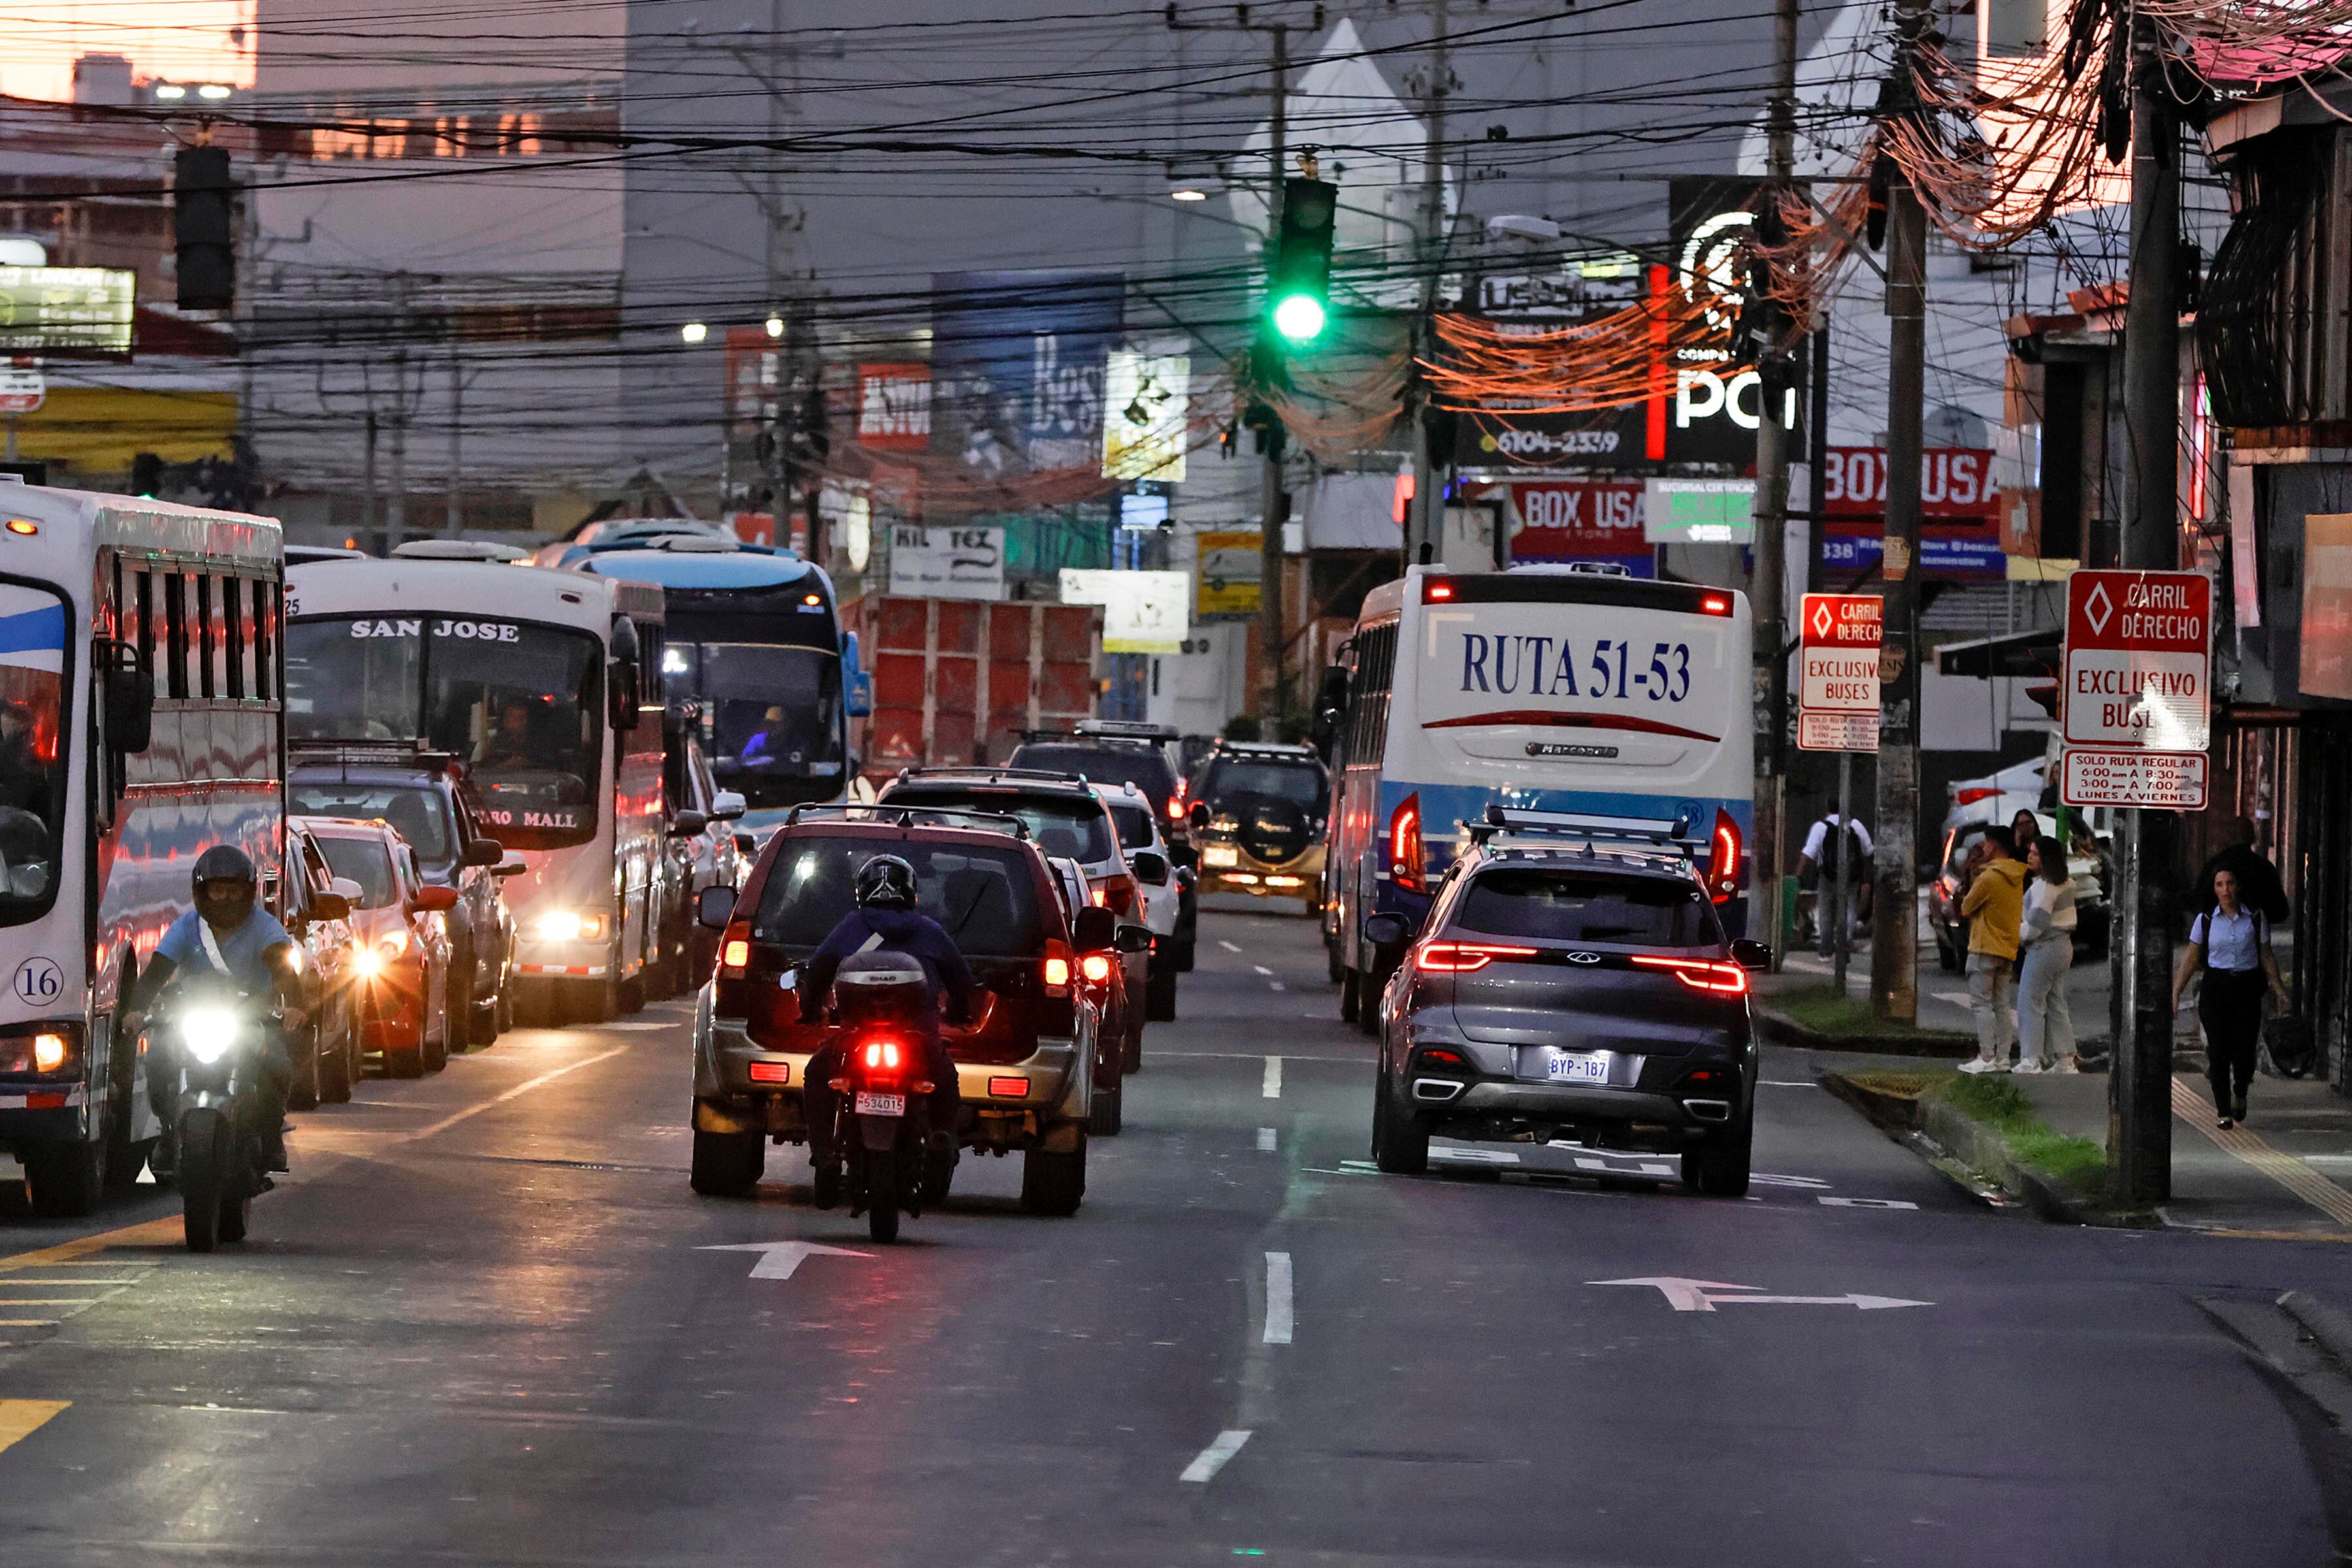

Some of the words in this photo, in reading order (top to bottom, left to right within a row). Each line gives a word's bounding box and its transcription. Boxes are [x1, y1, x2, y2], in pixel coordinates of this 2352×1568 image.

[1705, 482, 1757, 493] CERTIFICAD
[1525, 490, 1582, 528] BOX
[2127, 583, 2190, 610] CARRIL
[1840, 603, 1882, 621] CARRIL
[351, 621, 422, 638] SAN
[434, 621, 520, 643] JOSE
[2122, 614, 2200, 640] DERECHO
[1461, 633, 1579, 696] RUTA
[1590, 640, 1690, 702] 51-53
[1825, 683, 1870, 700] BUSES
[2078, 670, 2196, 696] EXCLUSIVO
[2076, 755, 2106, 765] SOLO
[2110, 757, 2138, 766] RUTA
[2142, 758, 2197, 768] REGULAR
[2082, 768, 2110, 777] 6:00
[2130, 769, 2139, 778] A
[2146, 770, 2174, 779] 8:30
[2081, 779, 2109, 788] 3:00
[2130, 781, 2139, 790] A
[2146, 781, 2173, 790] 7:00
[2138, 792, 2196, 802] VIERNES
[523, 812, 577, 828] MALL
[23, 968, 57, 996] 16
[864, 1098, 903, 1110] 534015
